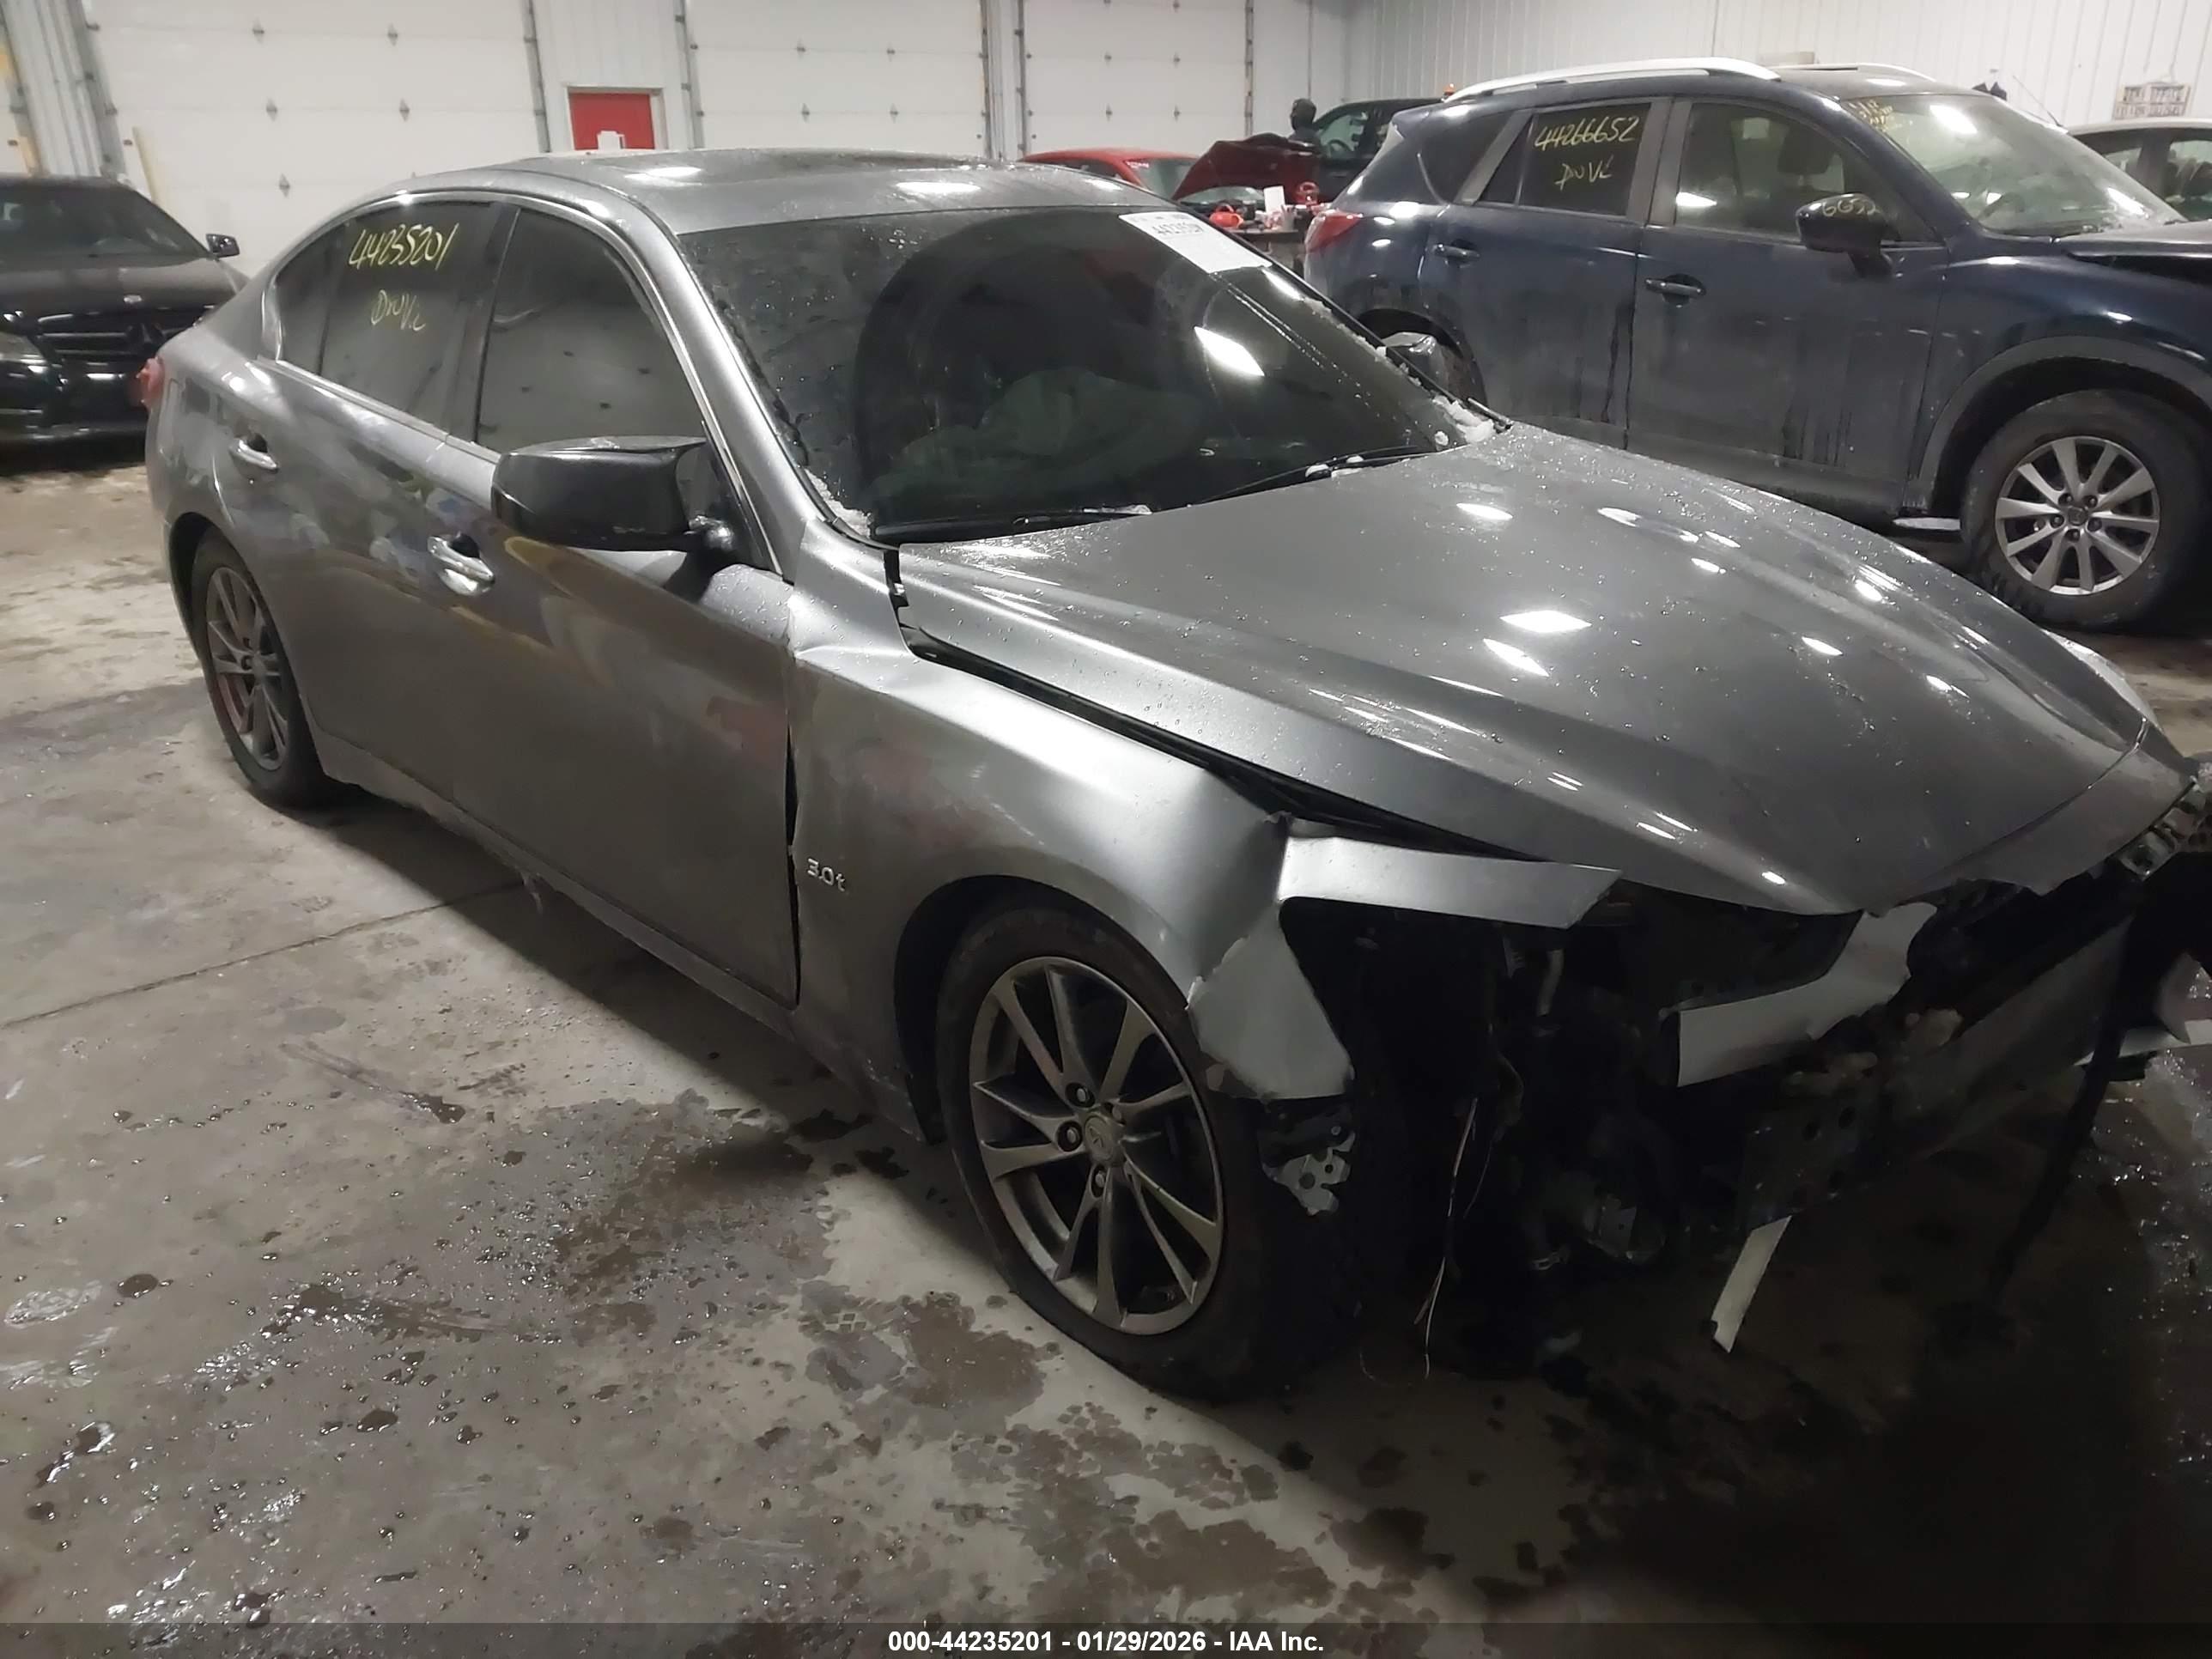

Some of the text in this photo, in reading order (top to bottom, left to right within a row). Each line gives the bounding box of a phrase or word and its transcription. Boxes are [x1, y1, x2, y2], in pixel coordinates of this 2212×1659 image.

[1534, 116, 1639, 150] 44266652
[349, 222, 459, 271] 44235201
[807, 858, 846, 892] 3.0t
